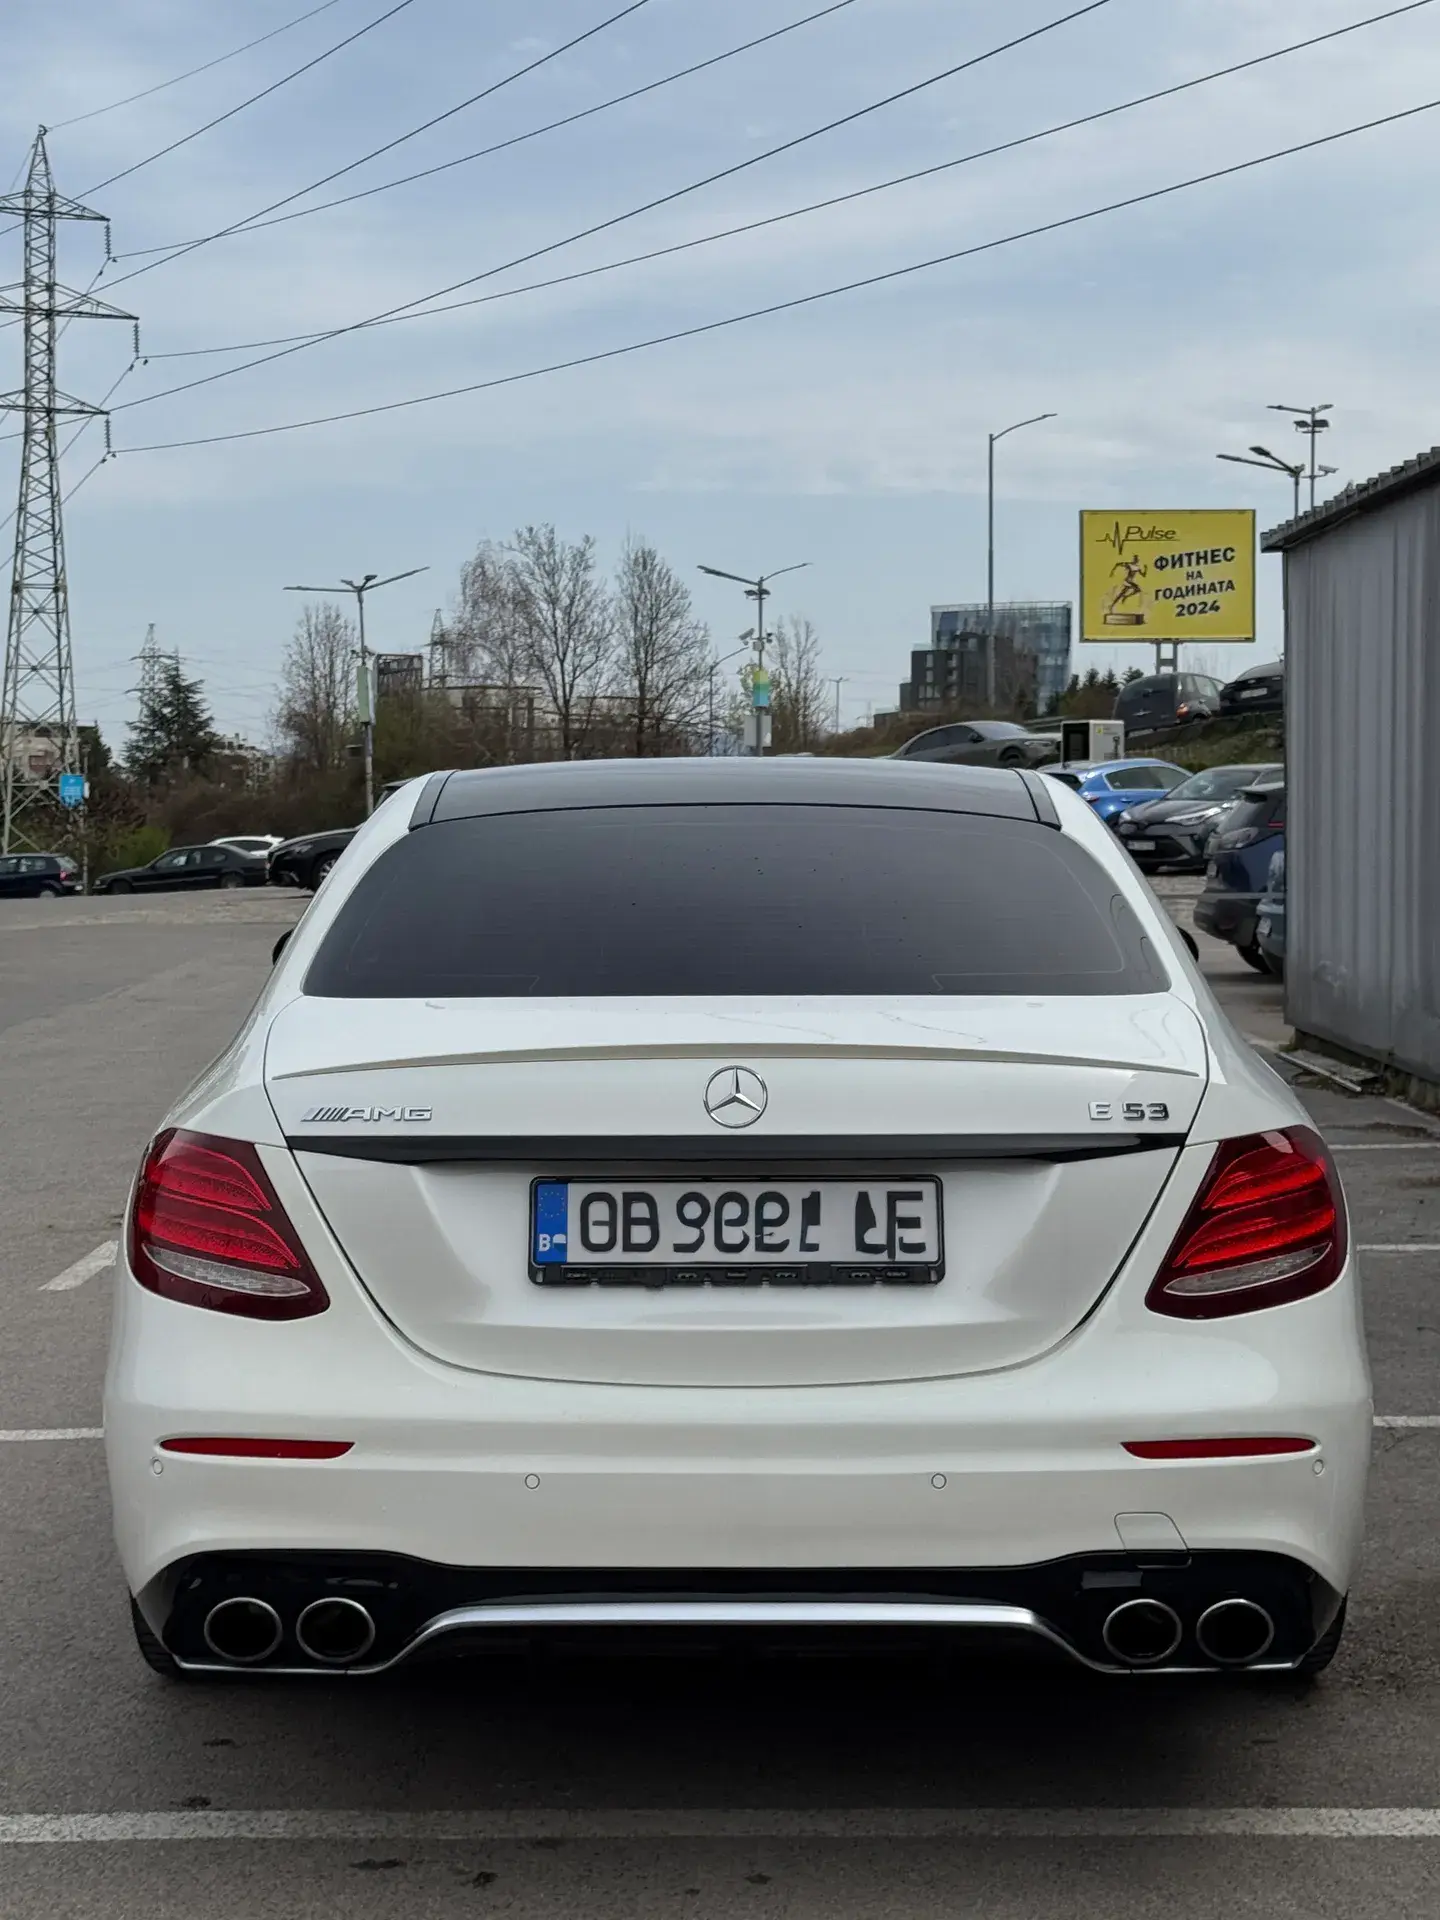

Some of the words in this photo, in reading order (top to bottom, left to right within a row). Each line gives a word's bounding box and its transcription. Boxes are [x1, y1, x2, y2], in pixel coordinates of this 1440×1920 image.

[1124, 525, 1177, 541] Pulse
[1154, 546, 1236, 572] ФИТНЕС
[1186, 570, 1204, 581] НА
[1154, 579, 1236, 601] ГОДИНАТА
[1175, 600, 1221, 618] 2024
[339, 1105, 433, 1122] AMG
[1088, 1101, 1113, 1121] E
[1121, 1101, 1170, 1121] 53
